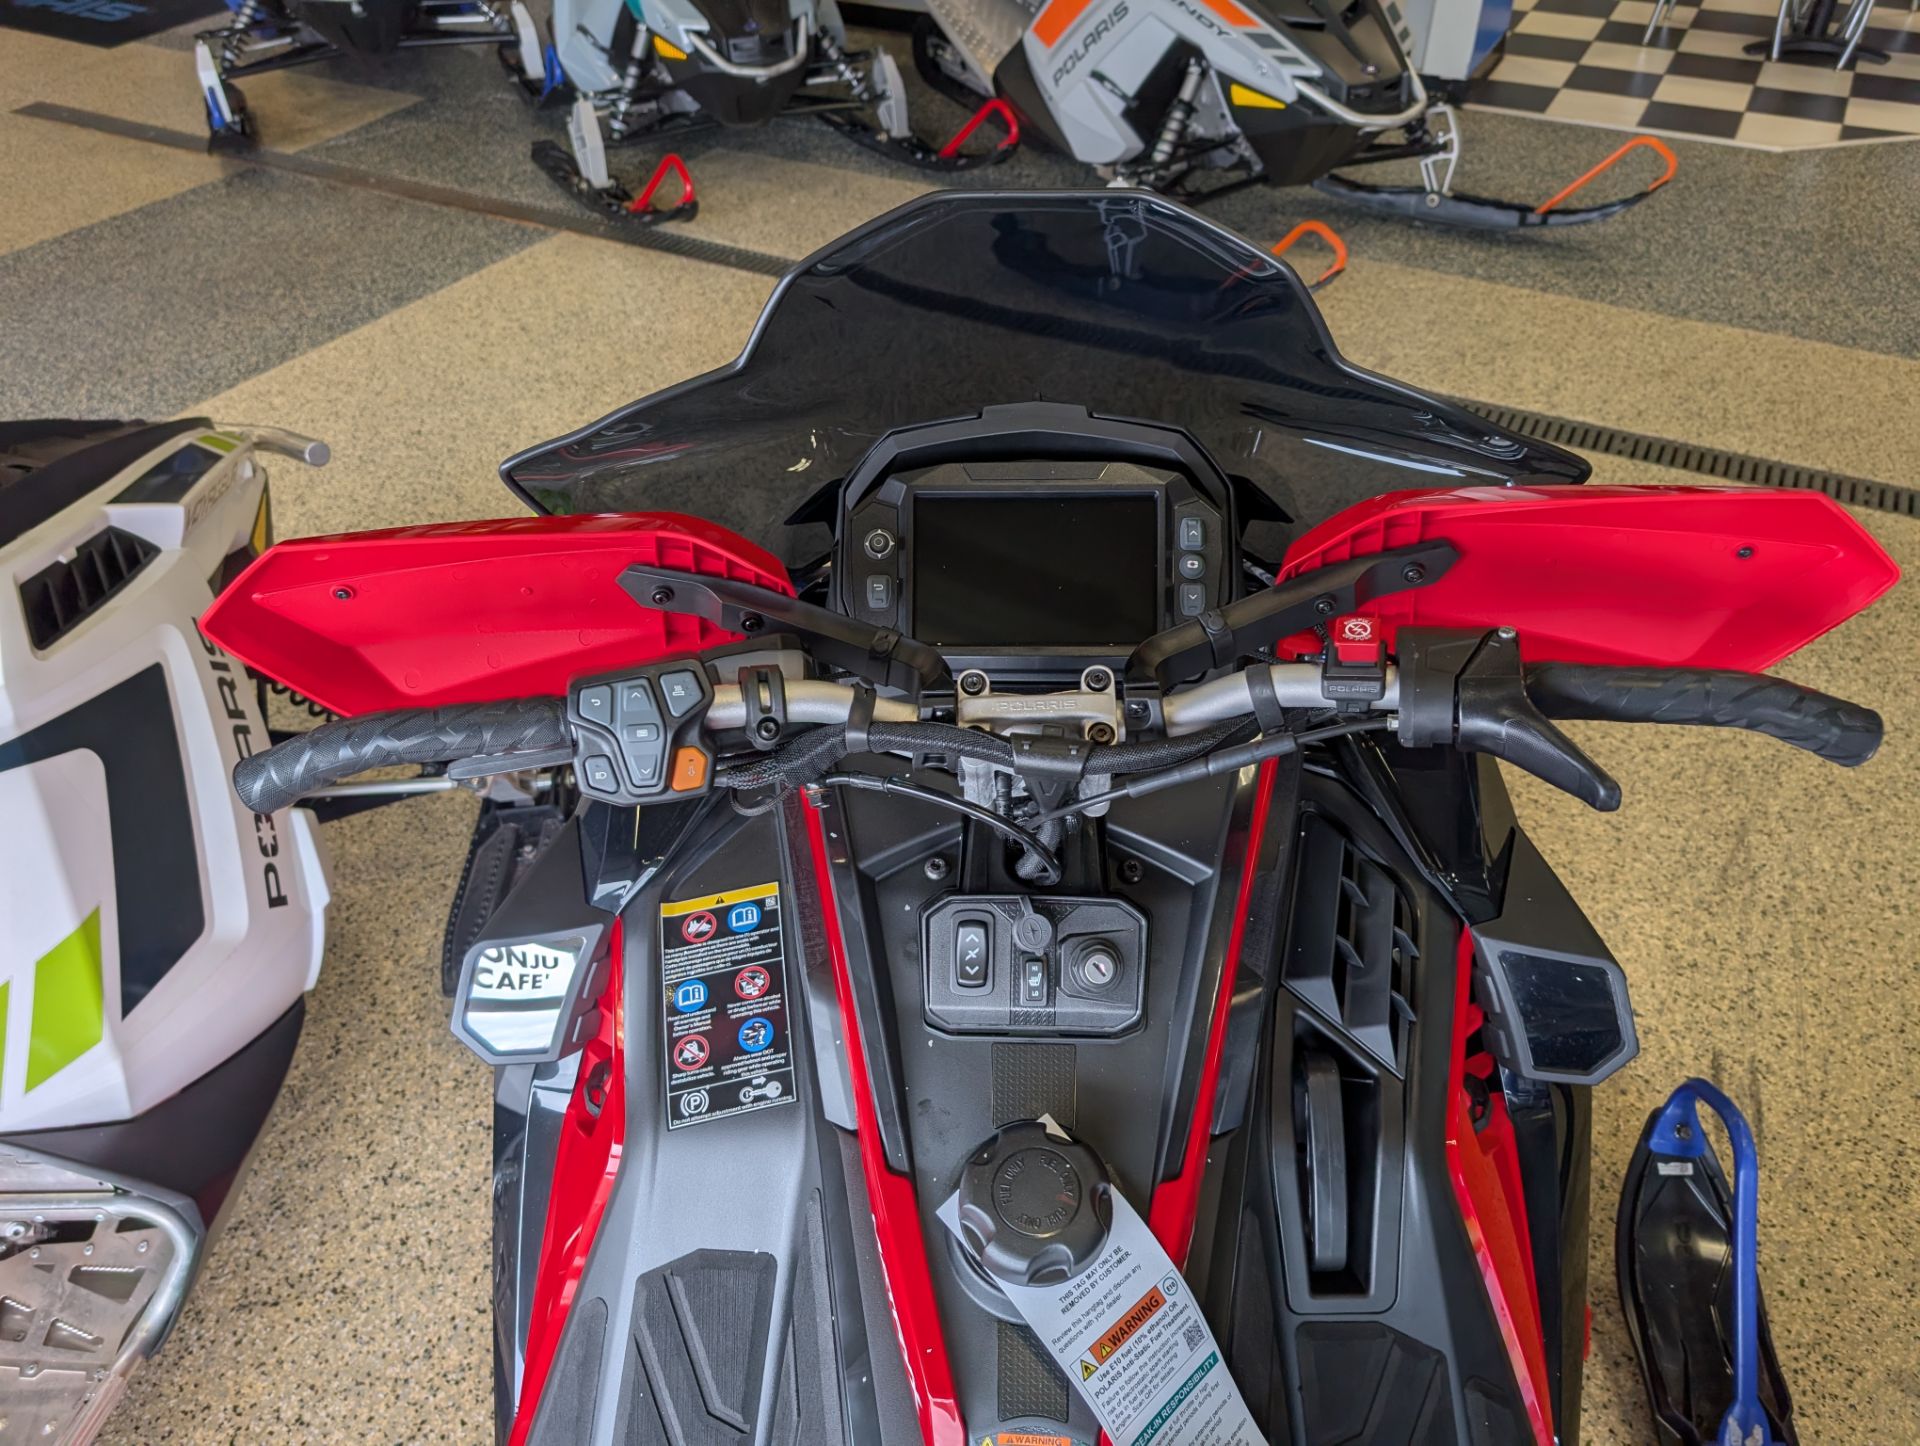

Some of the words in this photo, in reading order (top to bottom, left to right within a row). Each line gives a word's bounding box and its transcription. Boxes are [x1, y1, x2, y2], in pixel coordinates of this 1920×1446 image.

[1053, 1, 1130, 87] POLARIS
[1172, 0, 1231, 36] NDY
[996, 700, 1076, 712] POLARIS
[1329, 685, 1377, 693] POLARIS
[1058, 1289, 1073, 1303] THIS
[1072, 1278, 1085, 1290] TAG
[1085, 1267, 1097, 1280] MAY
[1098, 1253, 1113, 1268] ONLY
[1113, 1245, 1122, 1255] BE
[1061, 1287, 1090, 1313] REMOVED
[1089, 1279, 1098, 1289] BY
[1099, 1251, 1130, 1280] CUSTOMER.
[1166, 1281, 1177, 1291] E10
[1051, 1327, 1071, 1345] Review
[1071, 1318, 1082, 1328] this
[1081, 1299, 1103, 1318] hangtag
[1102, 1288, 1113, 1300] and
[1113, 1273, 1131, 1290] discuss
[1131, 1263, 1141, 1274] any
[1058, 1329, 1083, 1353] questions
[1083, 1319, 1094, 1330] with
[1094, 1308, 1105, 1321] your
[1109, 1297, 1158, 1345] WARNING
[1094, 1370, 1122, 1398] POLARIS
[1122, 1343, 1150, 1372] Anti-Static
[1150, 1329, 1162, 1344] Fuel
[1162, 1303, 1189, 1330] Treatment.
[1097, 1369, 1110, 1382] Use
[1109, 1357, 1121, 1370] E10
[1120, 1345, 1133, 1359] fuel
[1132, 1333, 1147, 1348] (10%
[1147, 1310, 1169, 1333] ethanol)
[1168, 1301, 1178, 1312] OR
[1101, 1390, 1119, 1408] Failure
[1124, 1371, 1139, 1385] follow
[1138, 1361, 1148, 1371] this
[1148, 1337, 1170, 1362] instruction
[1170, 1315, 1191, 1338] increases
[1107, 1406, 1116, 1416] risk
[1116, 1398, 1122, 1407] of
[1122, 1371, 1149, 1400] electrostatic
[1149, 1358, 1162, 1372] spark
[1162, 1340, 1178, 1358] starting
[1115, 1410, 1124, 1420] fire
[1128, 1393, 1138, 1405] fuel
[1137, 1384, 1148, 1395] tank
[1148, 1370, 1160, 1384] when
[1160, 1352, 1177, 1371] running
[1132, 1398, 1144, 1412] Scan
[1144, 1389, 1153, 1399] QR
[1161, 1358, 1212, 1417] RESPONSIBILITY
[1014, 1436, 1063, 1446] WARNING
